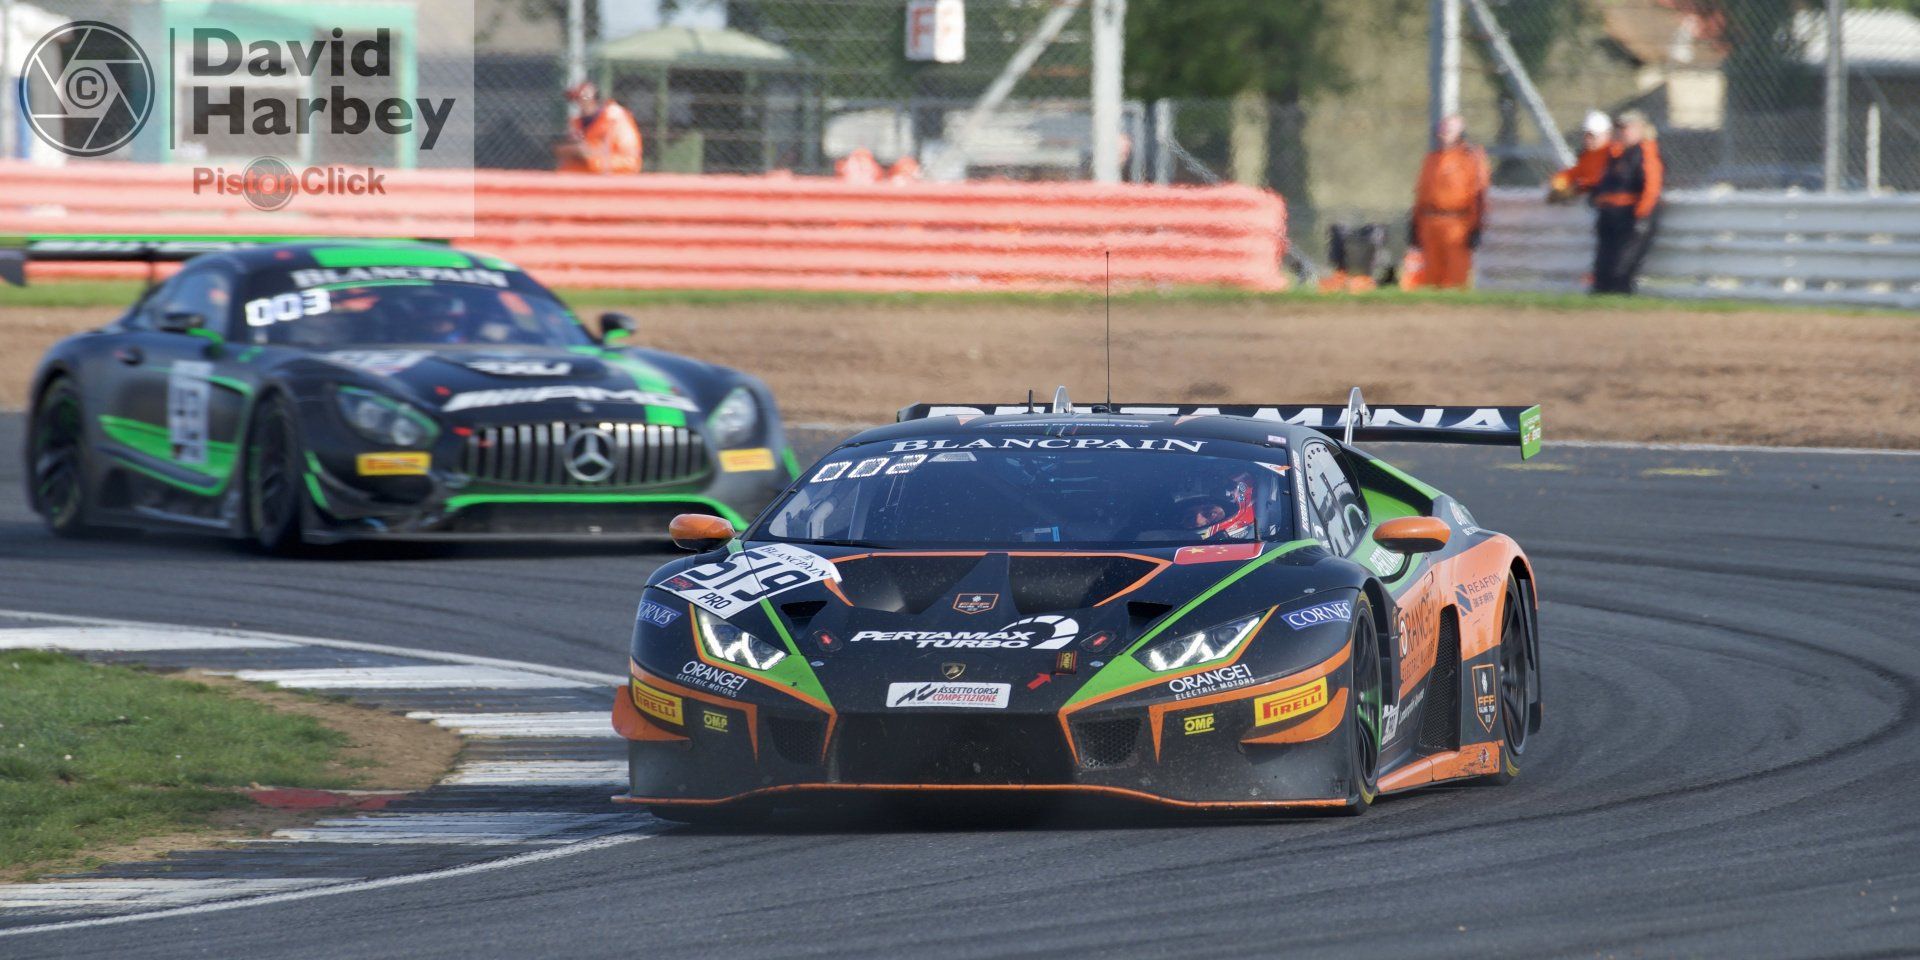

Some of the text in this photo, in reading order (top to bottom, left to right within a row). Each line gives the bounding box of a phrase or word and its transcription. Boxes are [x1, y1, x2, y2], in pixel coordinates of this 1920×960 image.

[290, 267, 509, 288] BLANCPAIN
[245, 287, 331, 327] 003
[887, 437, 1209, 453] BLANCPAIN
[760, 546, 831, 578] BLANCPAIN
[684, 550, 812, 602] 519
[1467, 572, 1501, 595] REAFON
[697, 592, 733, 610] PRO
[1288, 602, 1351, 626] CORNES
[850, 630, 1036, 642] PERTAMAX
[916, 638, 1029, 649] TURBO
[675, 673, 737, 698] ELECTRIC MOTORS
[682, 660, 748, 691] ORANGE1
[1168, 663, 1252, 693] ORANGE1
[932, 693, 998, 702] COMPETIZIONE
[937, 686, 972, 694] ASSETTO
[1175, 678, 1255, 701] ELECTRIC MOTORS
[634, 687, 677, 718] PIRELLI
[1262, 685, 1322, 720] PIRELLI
[703, 713, 728, 730] OMP
[1184, 716, 1215, 733] OMP
